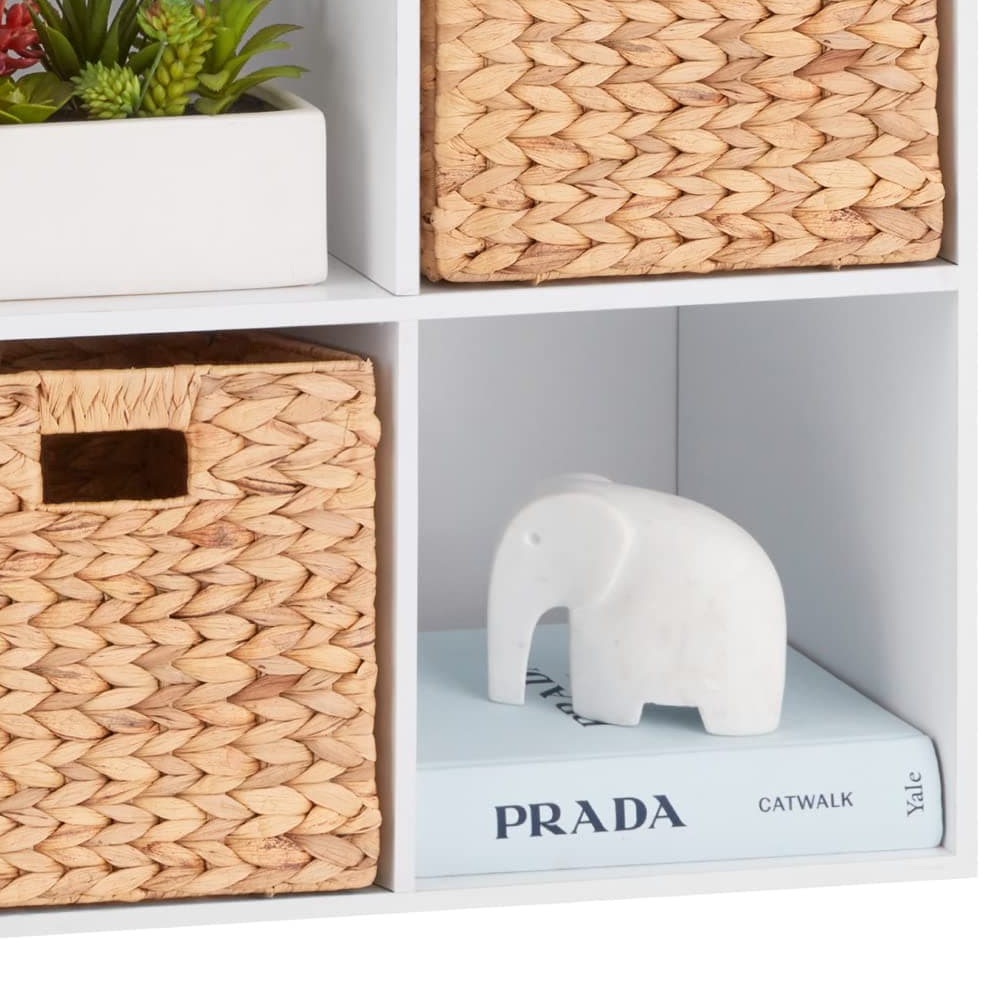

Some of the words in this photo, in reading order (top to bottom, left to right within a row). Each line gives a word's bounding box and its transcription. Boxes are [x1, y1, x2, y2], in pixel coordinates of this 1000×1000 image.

[494, 794, 688, 840] PRADA
[758, 791, 854, 813] CATWALK
[904, 771, 924, 817] Yale
